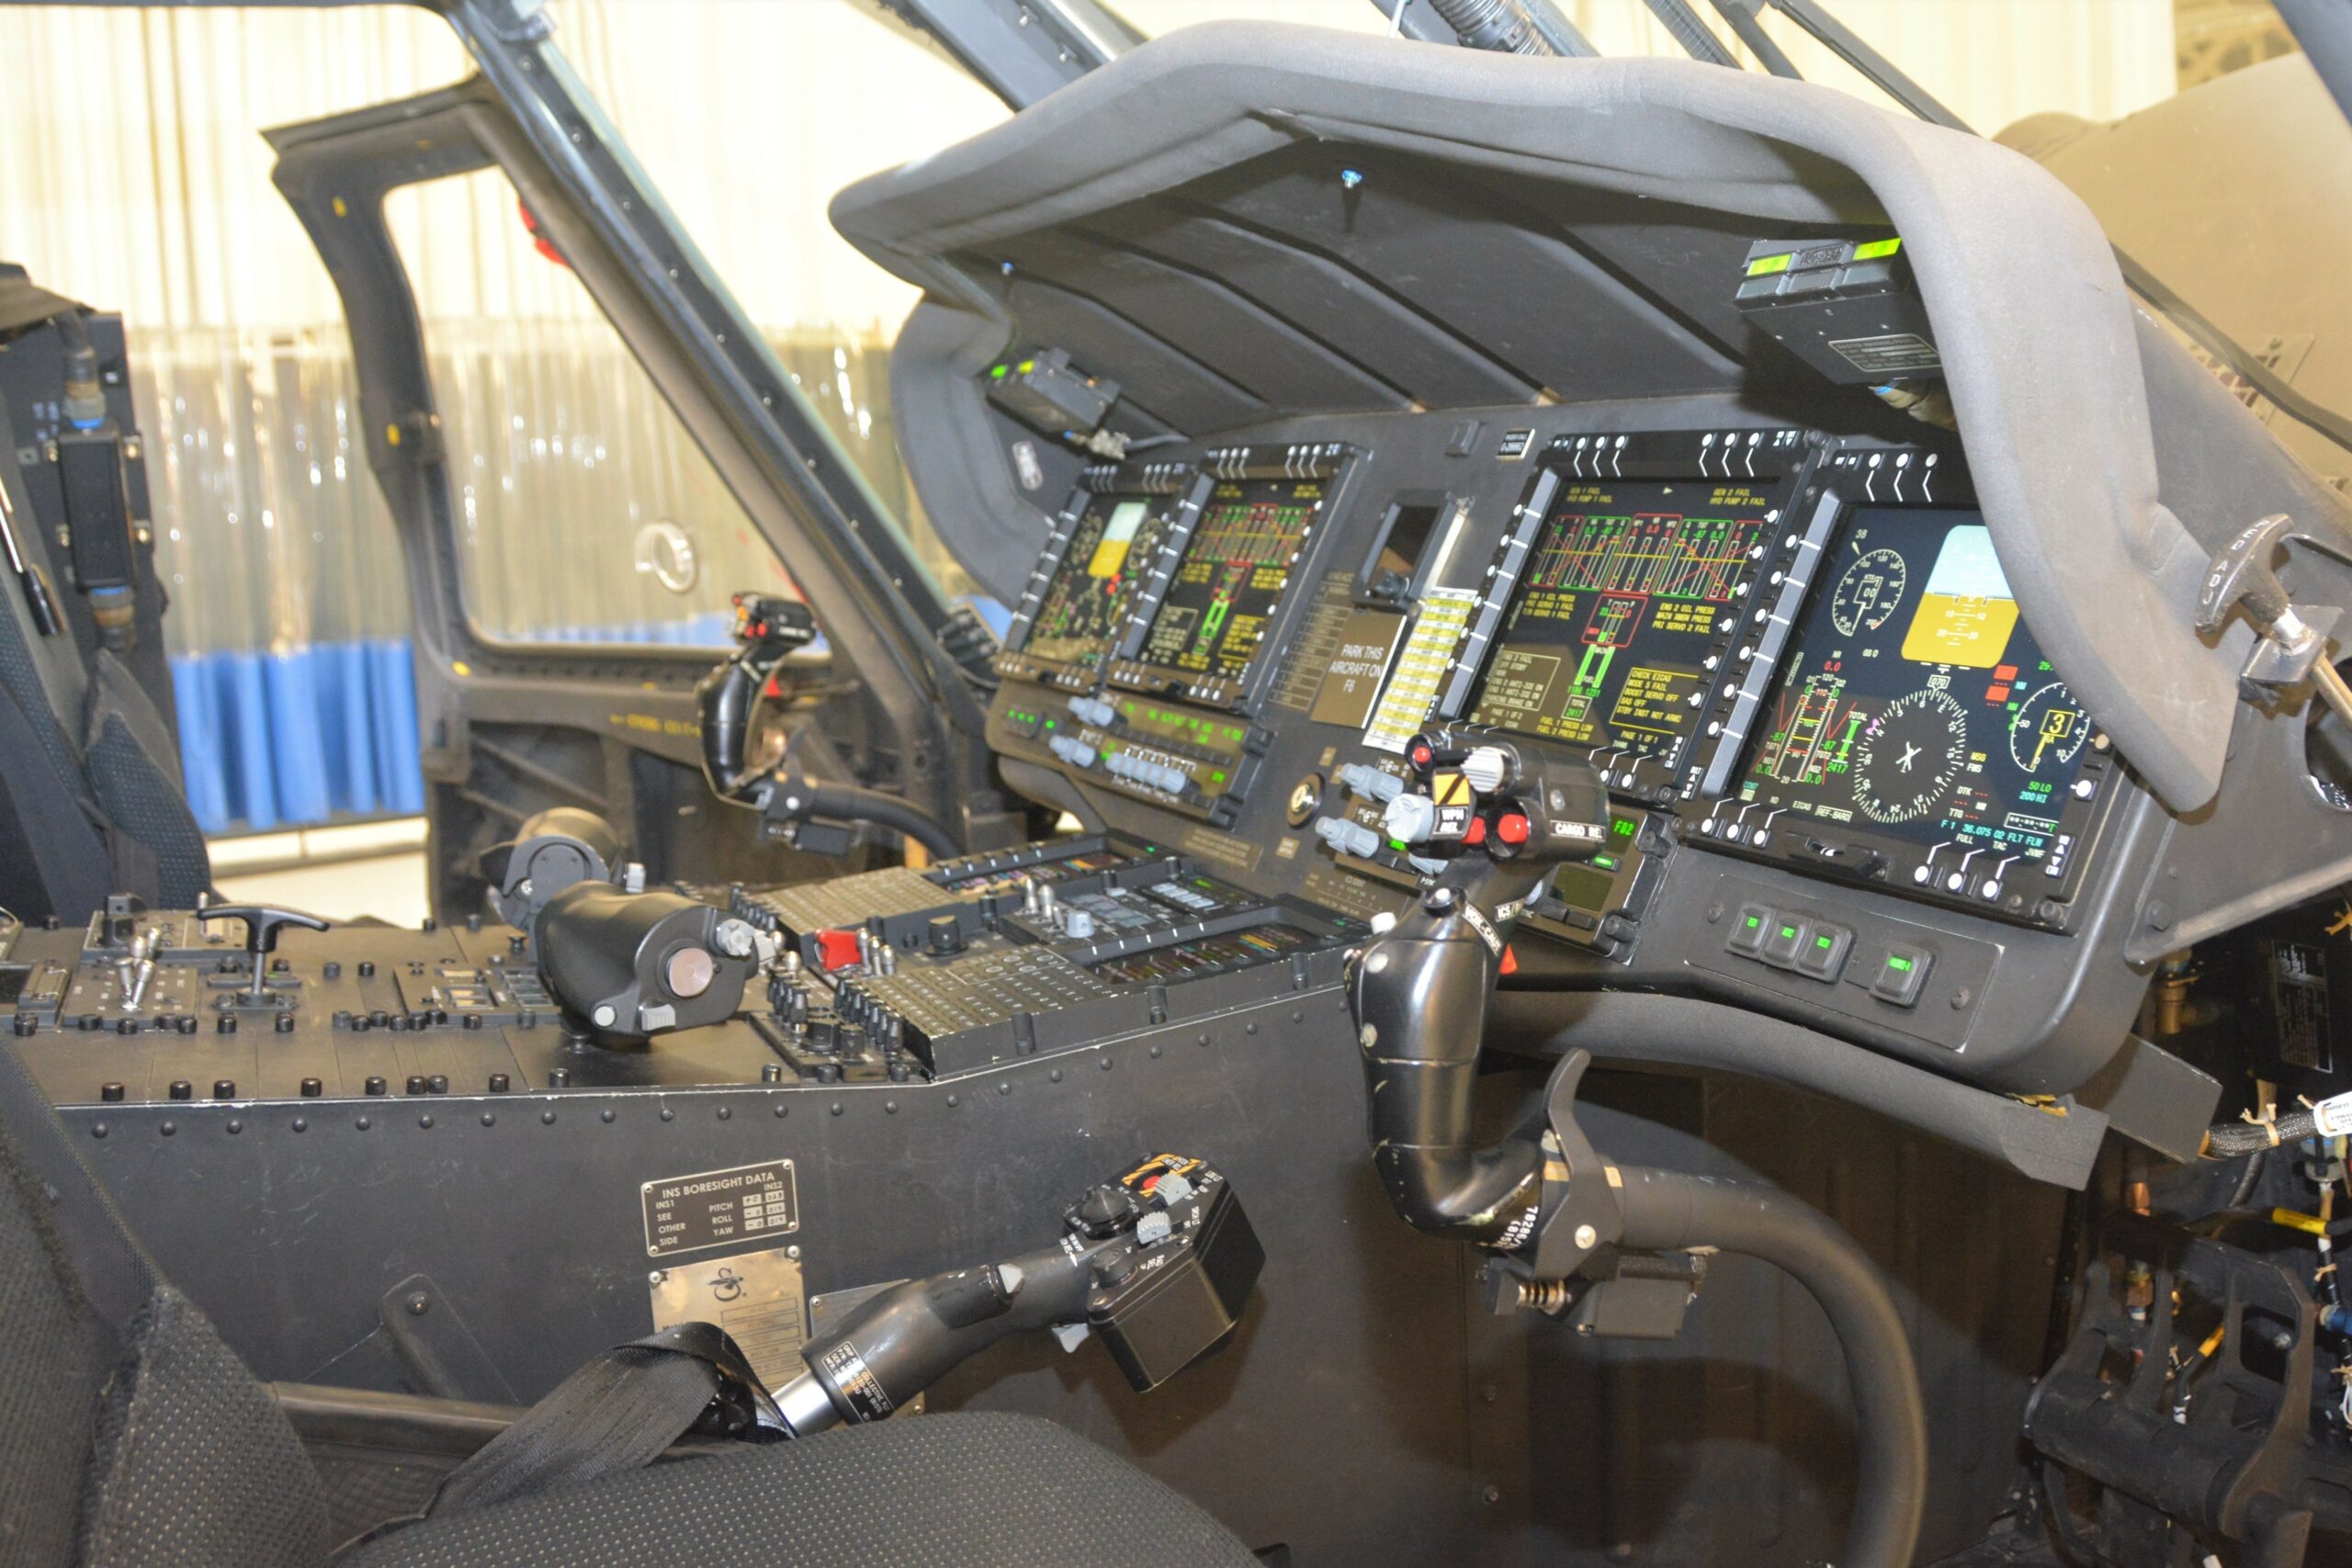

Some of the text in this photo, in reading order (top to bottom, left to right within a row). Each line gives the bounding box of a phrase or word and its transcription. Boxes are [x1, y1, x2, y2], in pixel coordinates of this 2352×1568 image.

[1560, 603, 1574, 611] FAIL
[1660, 603, 1673, 611] ENG
[1680, 604, 1692, 613] OIL
[1695, 605, 1716, 615] PRESS
[1556, 611, 1571, 620] FAIL
[1691, 615, 1712, 624] PRESS
[1667, 622, 1685, 631] SERVO
[1694, 625, 1710, 634] FAIL
[1341, 644, 1384, 660] PARK THIS
[1329, 661, 1383, 677] AIRCRAFT ON
[1824, 661, 1842, 671] 0.0
[1632, 671, 1672, 682] CHECK EICAS
[1931, 678, 1945, 686] 070
[1652, 682, 1667, 691] FAIL
[1624, 689, 1679, 702] BOOST SERVO OFF
[1634, 698, 1647, 707] OFF
[1617, 706, 1632, 716] STBY
[1634, 708, 1649, 717] INST
[1651, 711, 1664, 720] NOT
[1849, 711, 1868, 721] TOTAL
[1540, 716, 1554, 725] FUEL
[1562, 719, 1580, 730] PRESS
[1581, 722, 1594, 733] LOW
[2049, 713, 2065, 733] 3
[1537, 725, 1551, 734] FUEL
[1558, 728, 1576, 739] PRESS
[1577, 732, 1591, 741] LOW
[1621, 730, 1637, 740] PAGE
[1644, 733, 1654, 743] OF
[1770, 733, 1785, 741] -87
[1821, 741, 1836, 750] -87
[1970, 752, 1986, 762] MSG
[1756, 764, 1771, 775] 0.0
[1826, 763, 1849, 774] 2417
[1967, 763, 1983, 773] FMS
[1806, 774, 1822, 785] 0.0
[1957, 786, 1972, 796] DTK
[2029, 781, 2052, 793] 50 LO
[2019, 791, 2048, 804] 200 HI
[1792, 801, 1812, 811] EICAS
[1949, 808, 1963, 819] TTG
[1555, 823, 1585, 837] CARGO
[1940, 820, 1948, 828] F
[1962, 823, 1992, 837] 36.075
[1994, 829, 2005, 839] 02
[2007, 832, 2023, 843] FLT
[1956, 833, 1973, 845] FULL
[1993, 840, 2007, 851] TAC
[662, 1171, 775, 1199] INS BORESIGHT DATA
[764, 1181, 783, 1191] INS2
[655, 1200, 675, 1210] INS1
[708, 1202, 734, 1213] PITCH
[657, 1212, 672, 1222] SEE
[712, 1215, 733, 1224] ROLL
[658, 1223, 686, 1234] OTHER
[712, 1226, 734, 1236] YAW
[659, 1236, 678, 1247] SIDE
